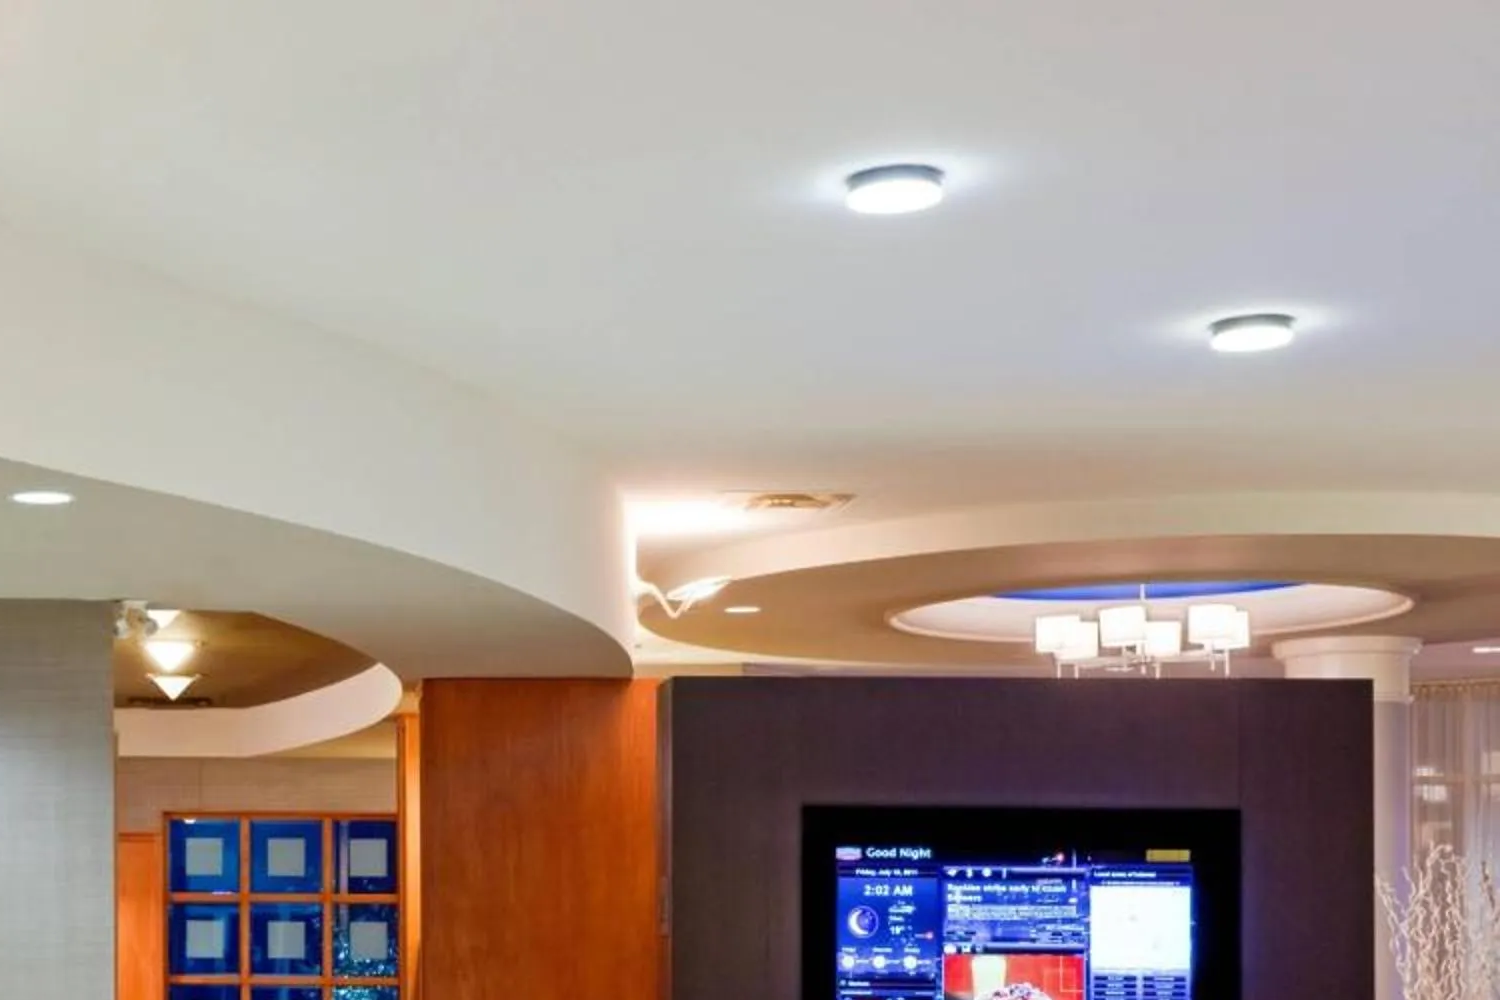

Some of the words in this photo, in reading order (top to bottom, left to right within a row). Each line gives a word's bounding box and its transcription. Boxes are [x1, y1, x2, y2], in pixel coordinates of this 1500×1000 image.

[866, 847, 897, 859] Good
[900, 847, 932, 861] Night
[863, 883, 890, 897] 2:02
[892, 883, 914, 897] AM
